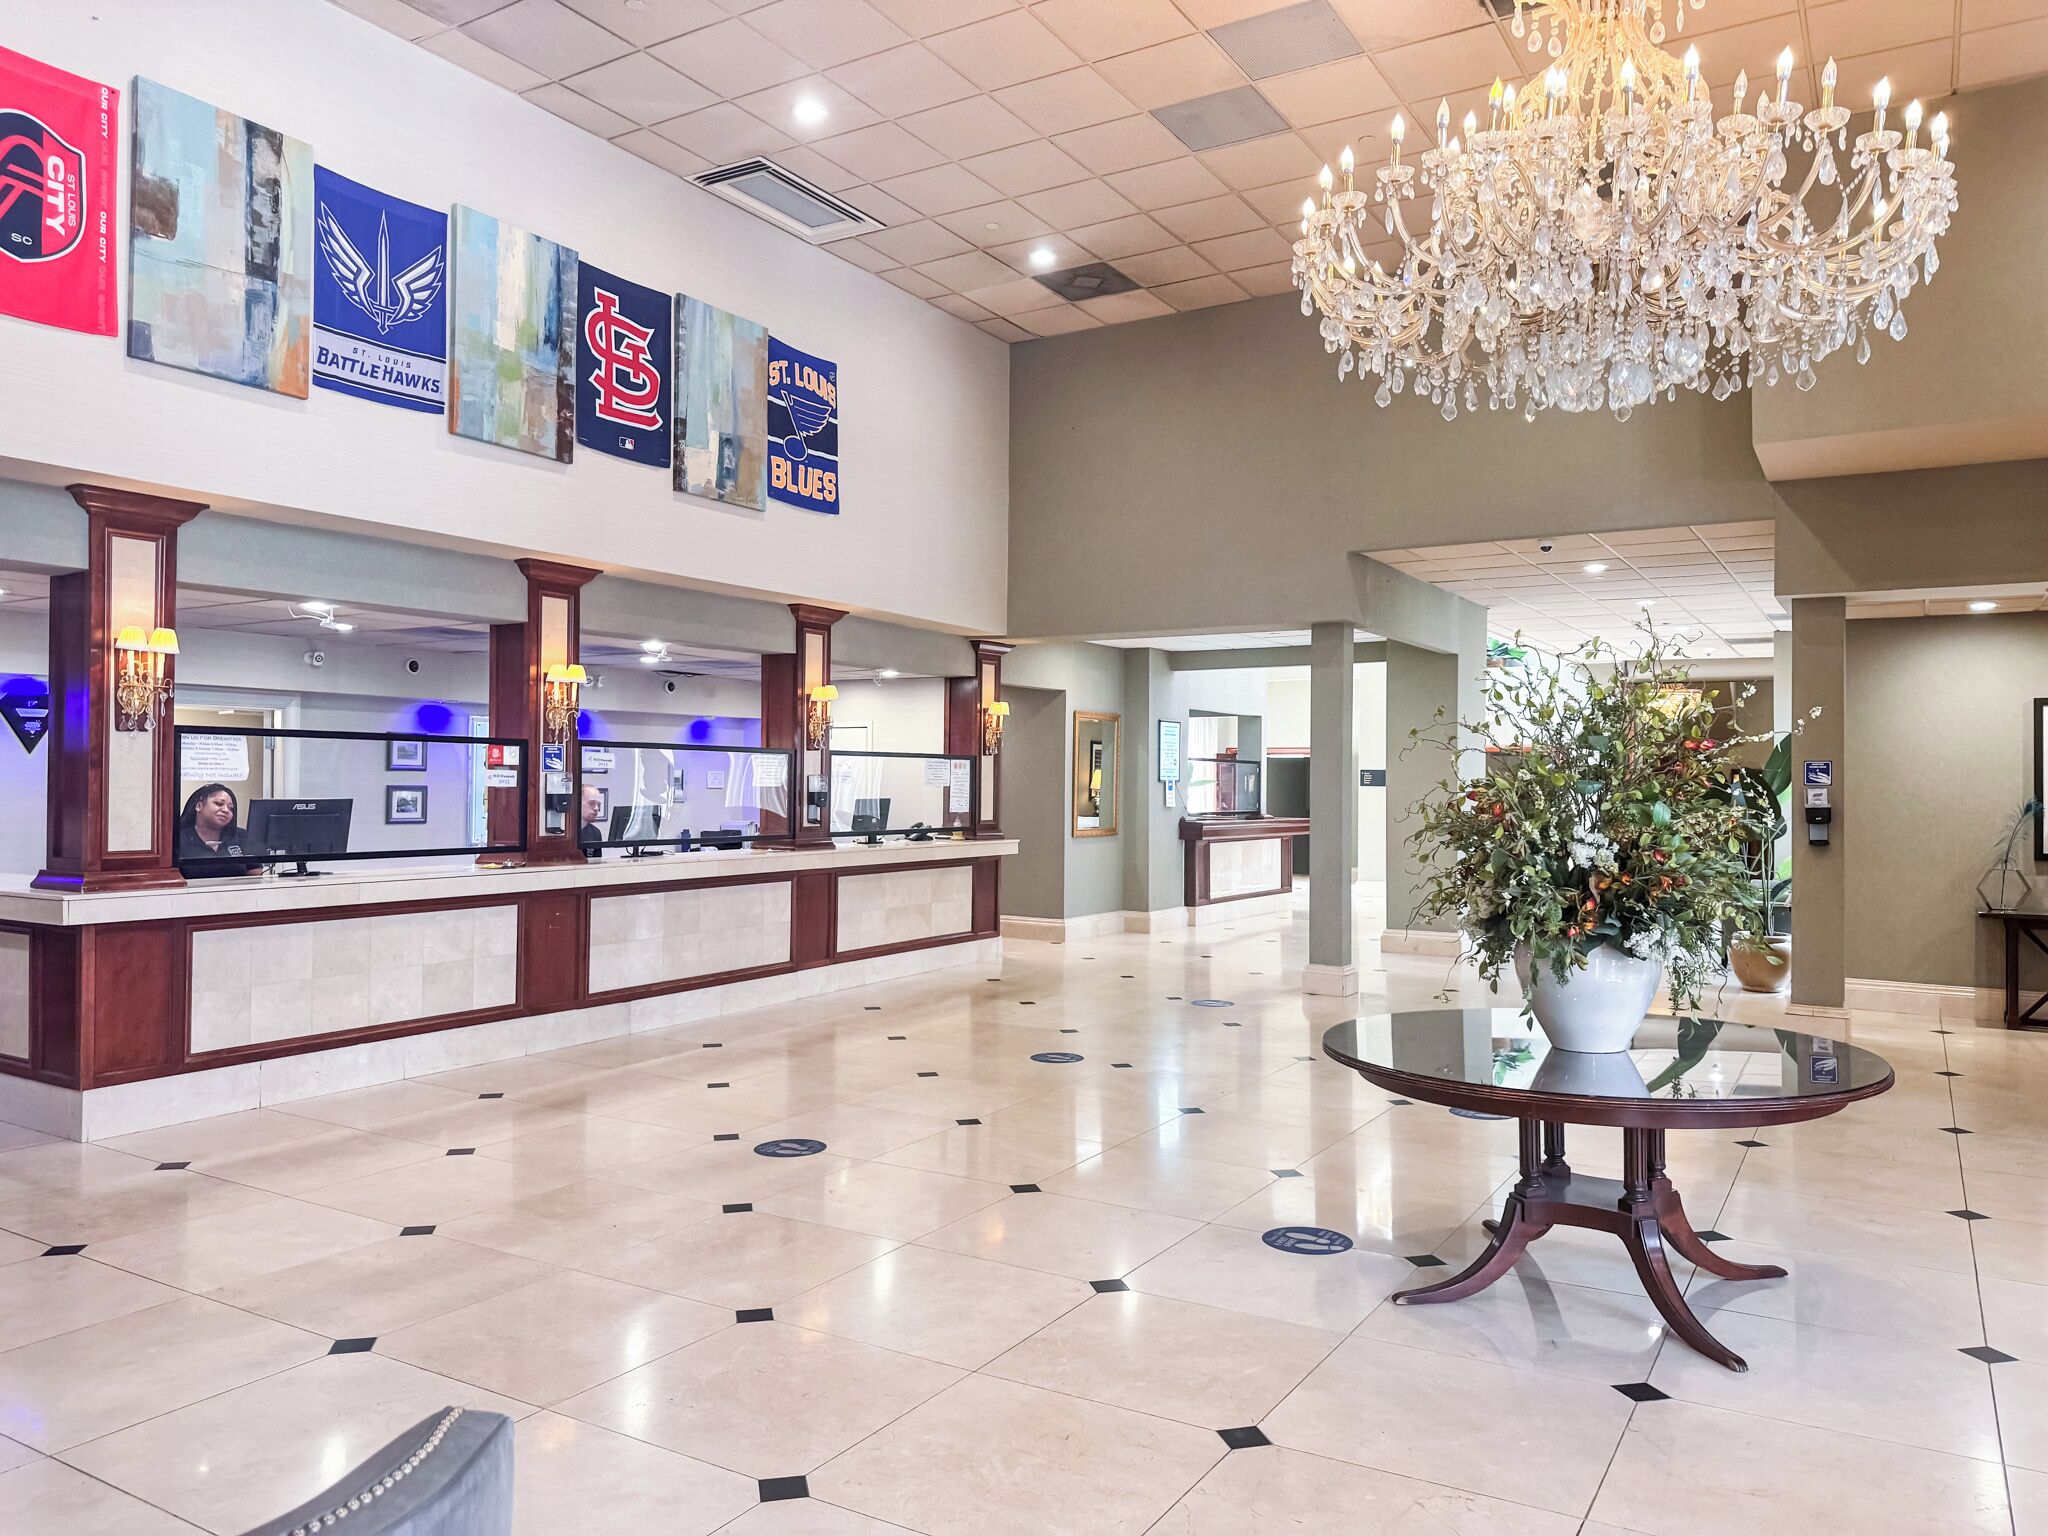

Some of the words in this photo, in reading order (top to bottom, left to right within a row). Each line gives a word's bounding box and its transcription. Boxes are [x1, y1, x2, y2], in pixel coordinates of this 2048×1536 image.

[46, 155, 66, 238] CITY
[67, 174, 76, 190] ST
[67, 192, 76, 227] LOUIS
[11, 232, 33, 246] SC
[99, 237, 107, 263] CITY
[352, 347, 371, 358] ST.
[378, 355, 412, 369] LOUIS
[769, 360, 791, 386] ST.
[794, 362, 837, 410] LOUIS
[771, 455, 837, 503] BLUES
